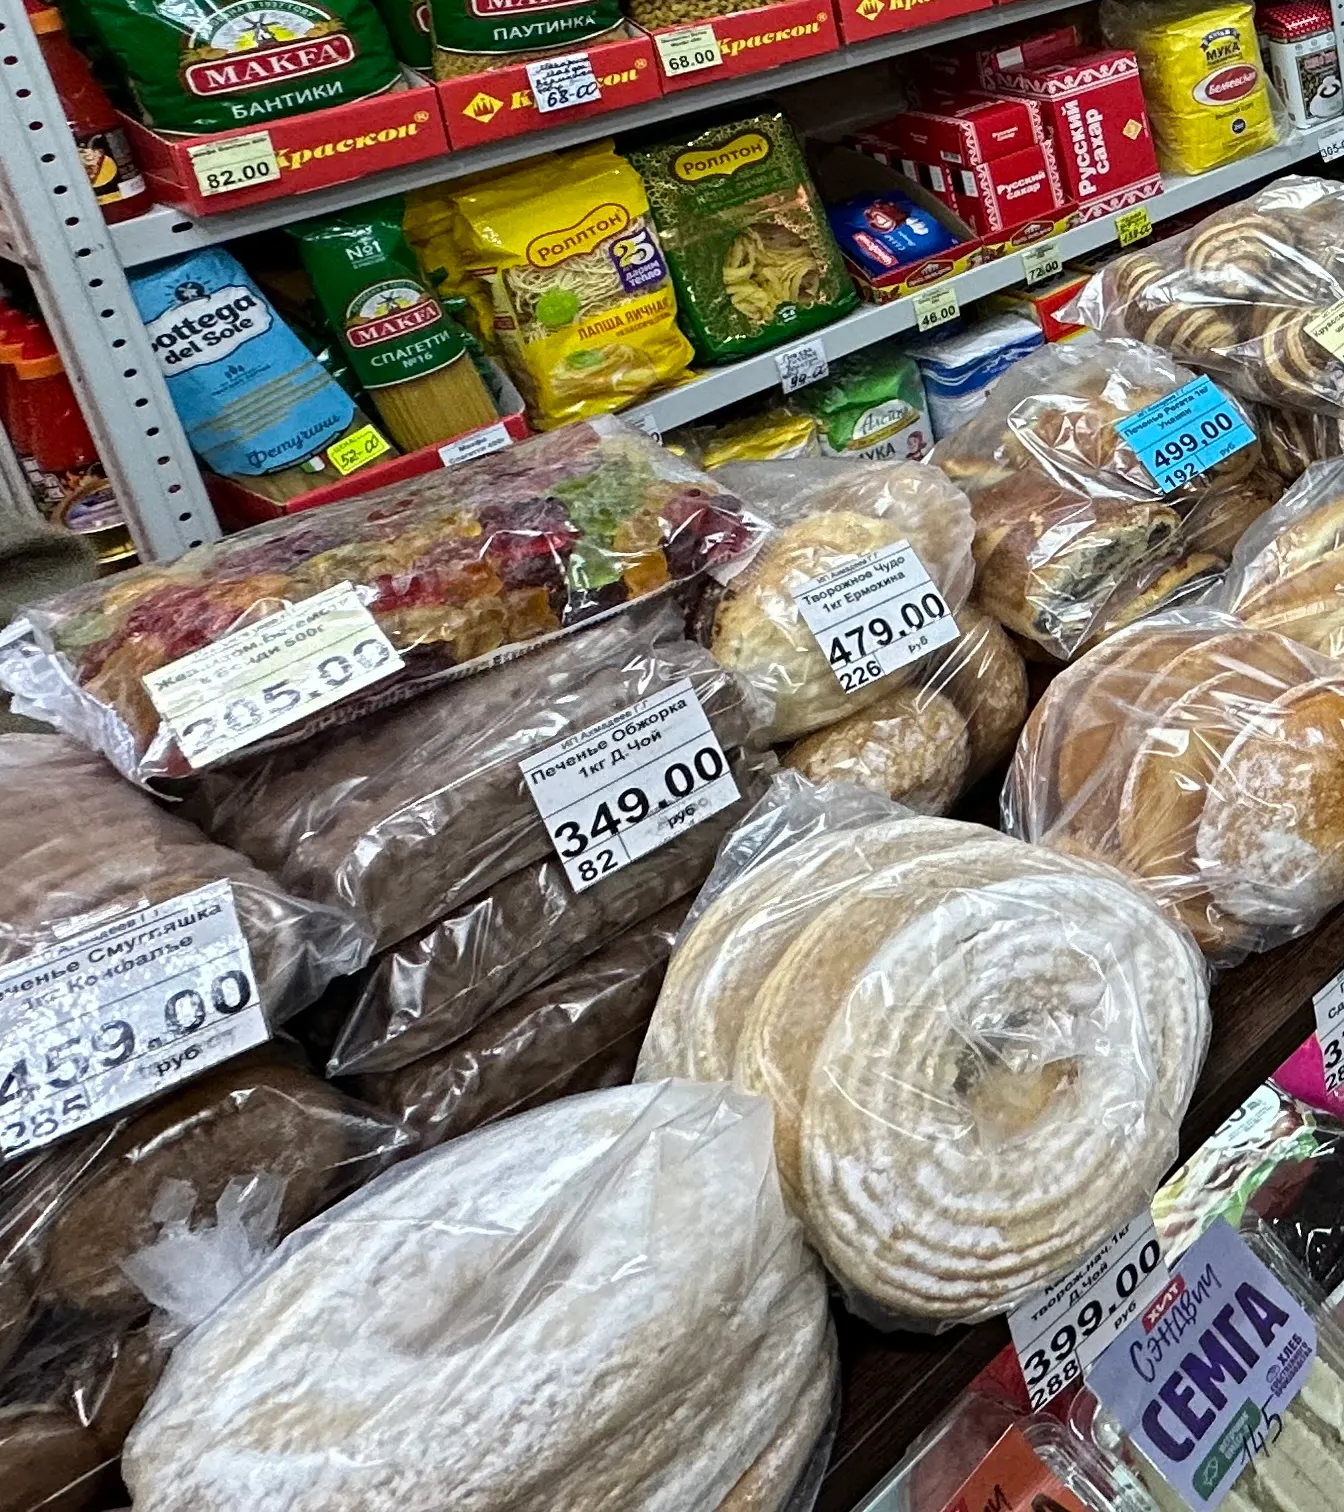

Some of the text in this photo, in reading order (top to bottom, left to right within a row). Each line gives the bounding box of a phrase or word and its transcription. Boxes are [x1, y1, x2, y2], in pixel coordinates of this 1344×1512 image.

[493, 15, 597, 42] ПАУТИНКА
[204, 41, 339, 90] MAKFA
[669, 49, 716, 71] 68.00
[1205, 40, 1241, 62] МУКА
[231, 80, 344, 121] БАНТИКИ
[683, 140, 764, 176] Роллтон
[1065, 98, 1095, 196] Русский
[1086, 108, 1111, 175] сахар
[207, 161, 270, 188] 82.00
[997, 170, 1046, 196] Русский
[538, 211, 622, 262] Роллтон
[357, 303, 438, 343] MAKFA
[921, 304, 957, 329] 46.00
[165, 315, 256, 367] del Sole
[370, 329, 452, 368] СПАГЕТТИ
[1154, 412, 1233, 469] 499,00
[1164, 461, 1199, 488] 192
[802, 554, 906, 606] Творожное Чудо
[822, 570, 906, 614] 1кг Ермохина
[829, 592, 946, 665] 479.00
[839, 660, 883, 693] 226
[530, 738, 609, 785] Печенье
[610, 698, 688, 743] Обжорка
[577, 759, 607, 780] 1кг
[553, 746, 724, 859] 349.00
[666, 804, 697, 829] руб
[578, 848, 620, 883] 82
[87, 901, 223, 963] Смугляшка
[0, 969, 252, 1105] 459.00
[156, 1046, 200, 1077] руб
[1024, 1238, 1162, 1386] 399.00
[1113, 1300, 1137, 1330] руб
[1146, 1283, 1179, 1323] ХИТ
[1276, 1332, 1303, 1367] ХЛЕБ
[1030, 1358, 1080, 1411] 288
[1140, 1281, 1290, 1463] СЕМГА
